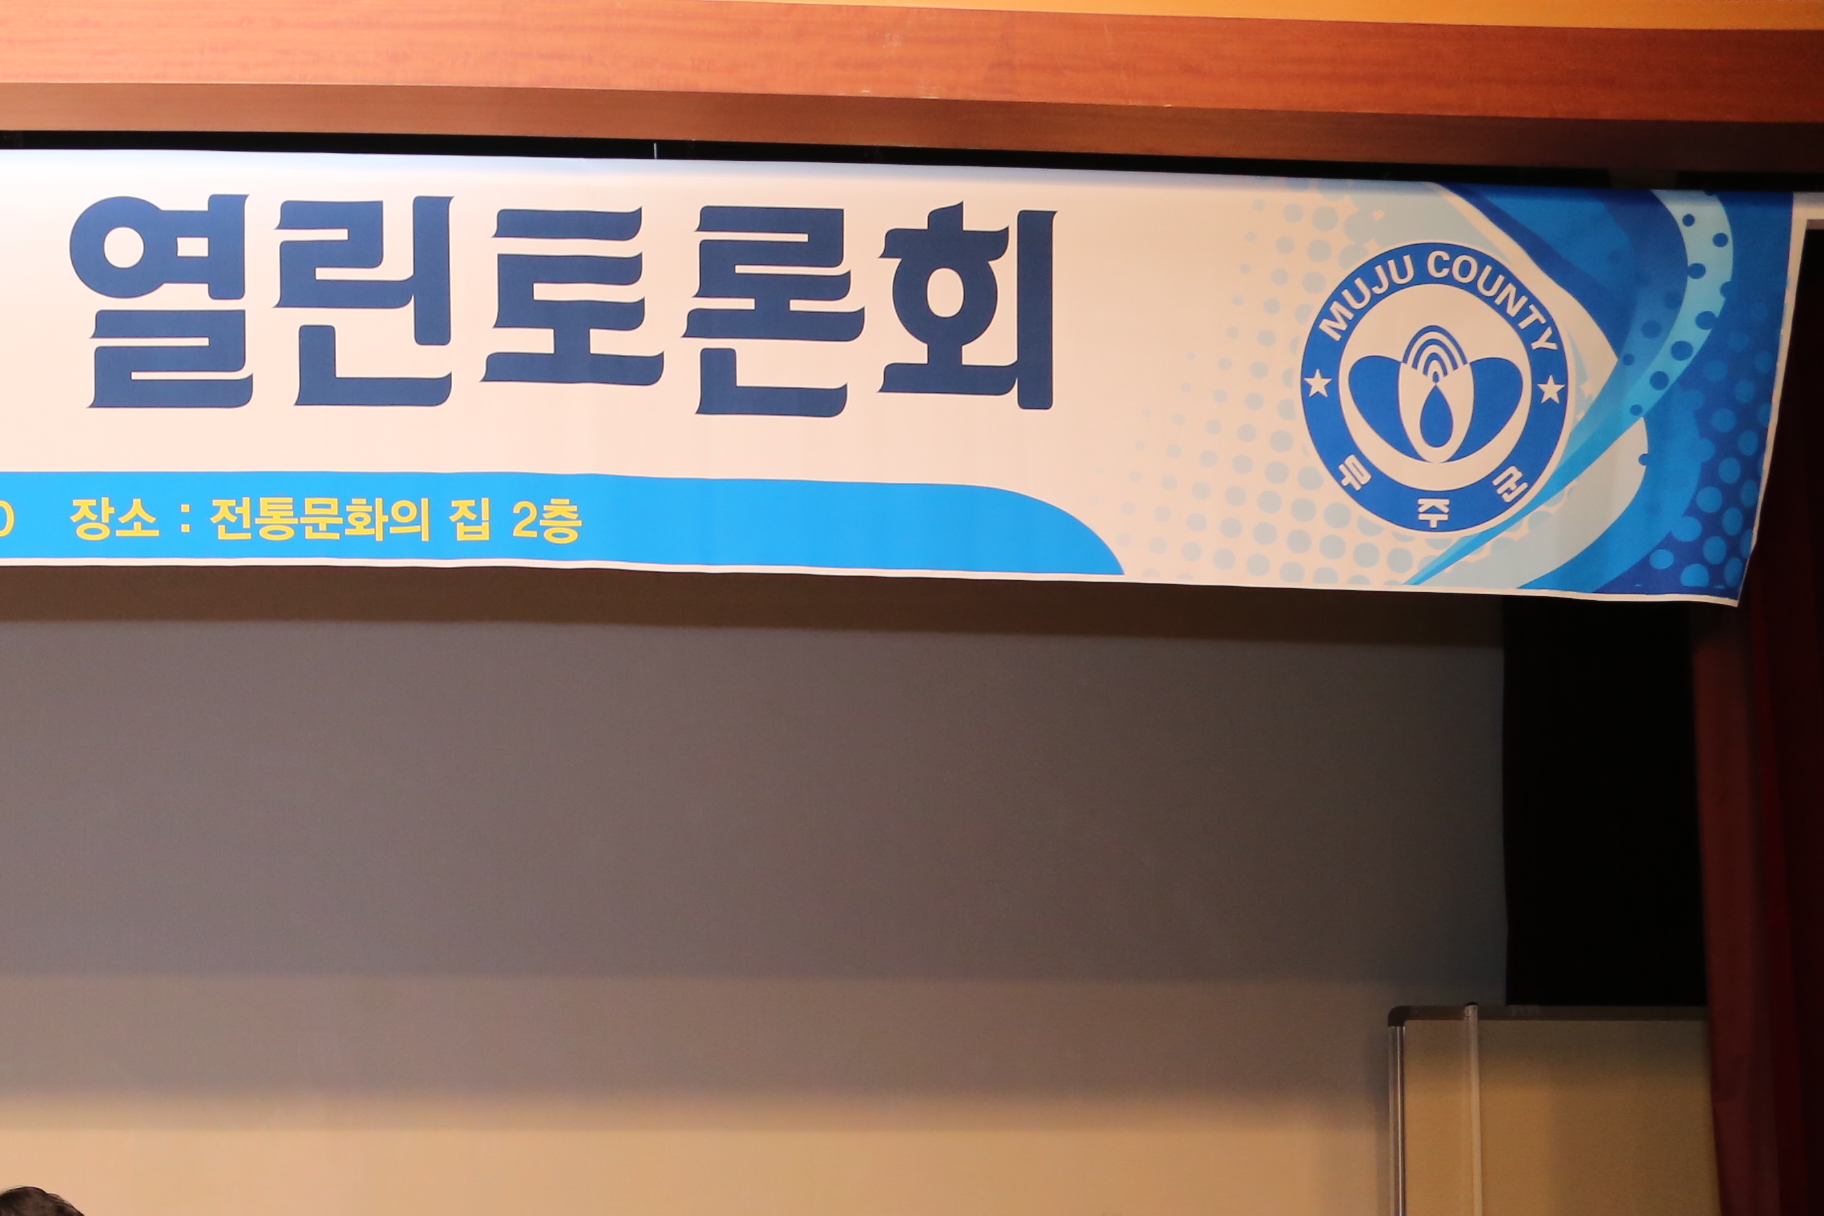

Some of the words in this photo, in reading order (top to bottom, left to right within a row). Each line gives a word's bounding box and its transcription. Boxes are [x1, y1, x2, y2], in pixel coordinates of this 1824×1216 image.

[70, 194, 1051, 417] 열린토론회
[1316, 253, 1417, 343] MUJU
[1426, 249, 1559, 356] COUNTY
[68, 497, 161, 542] 장소
[209, 496, 432, 542] 전통문화의
[450, 497, 490, 541] 집
[513, 498, 583, 544] 2층
